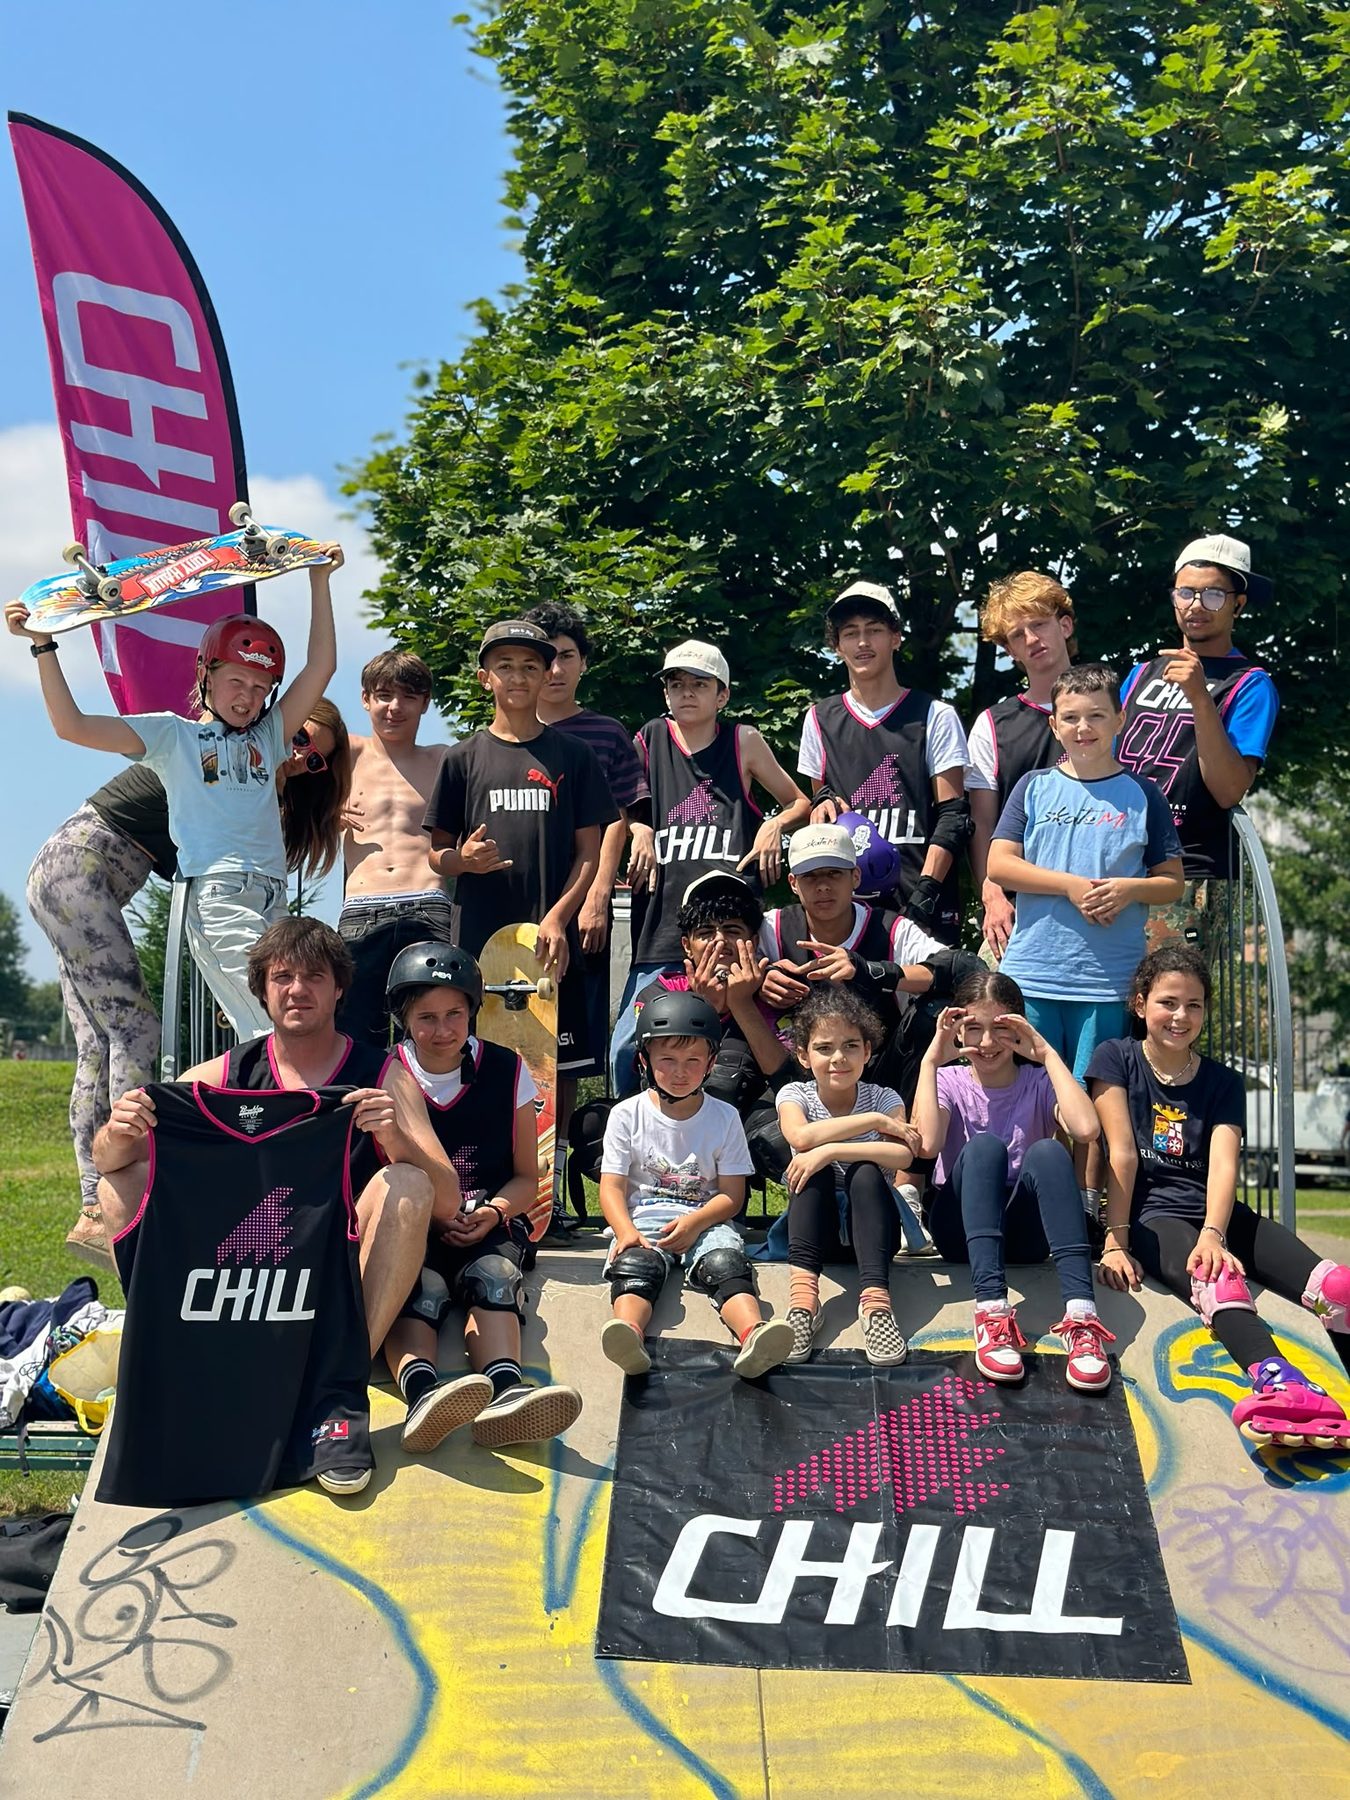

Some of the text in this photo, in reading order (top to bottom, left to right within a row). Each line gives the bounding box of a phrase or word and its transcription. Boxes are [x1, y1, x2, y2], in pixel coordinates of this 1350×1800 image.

[489, 788, 551, 812] PUMA
[655, 825, 740, 865] CHILL
[180, 1268, 316, 1321] CHILL
[334, 1422, 344, 1433] L
[652, 1513, 1124, 1636] CHILL
